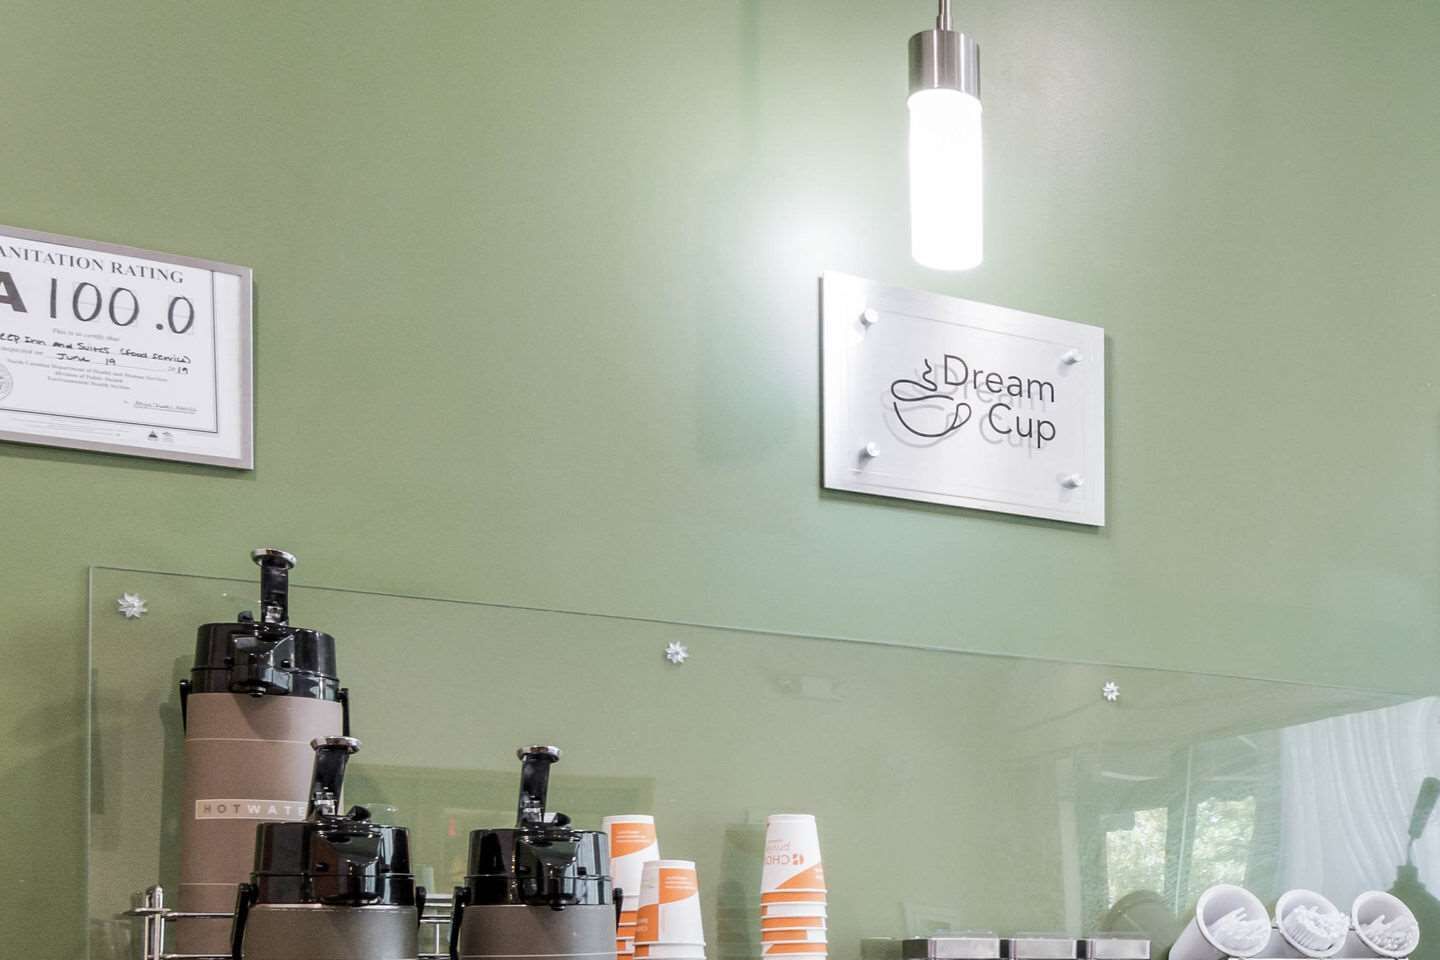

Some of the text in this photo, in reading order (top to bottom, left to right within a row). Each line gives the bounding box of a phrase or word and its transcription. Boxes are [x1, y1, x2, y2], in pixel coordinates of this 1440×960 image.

[0, 246, 184, 284] ANITATION RATING
[944, 354, 1055, 402] Dream
[988, 403, 1056, 448] Cup
[203, 804, 306, 816] HOT WATE
